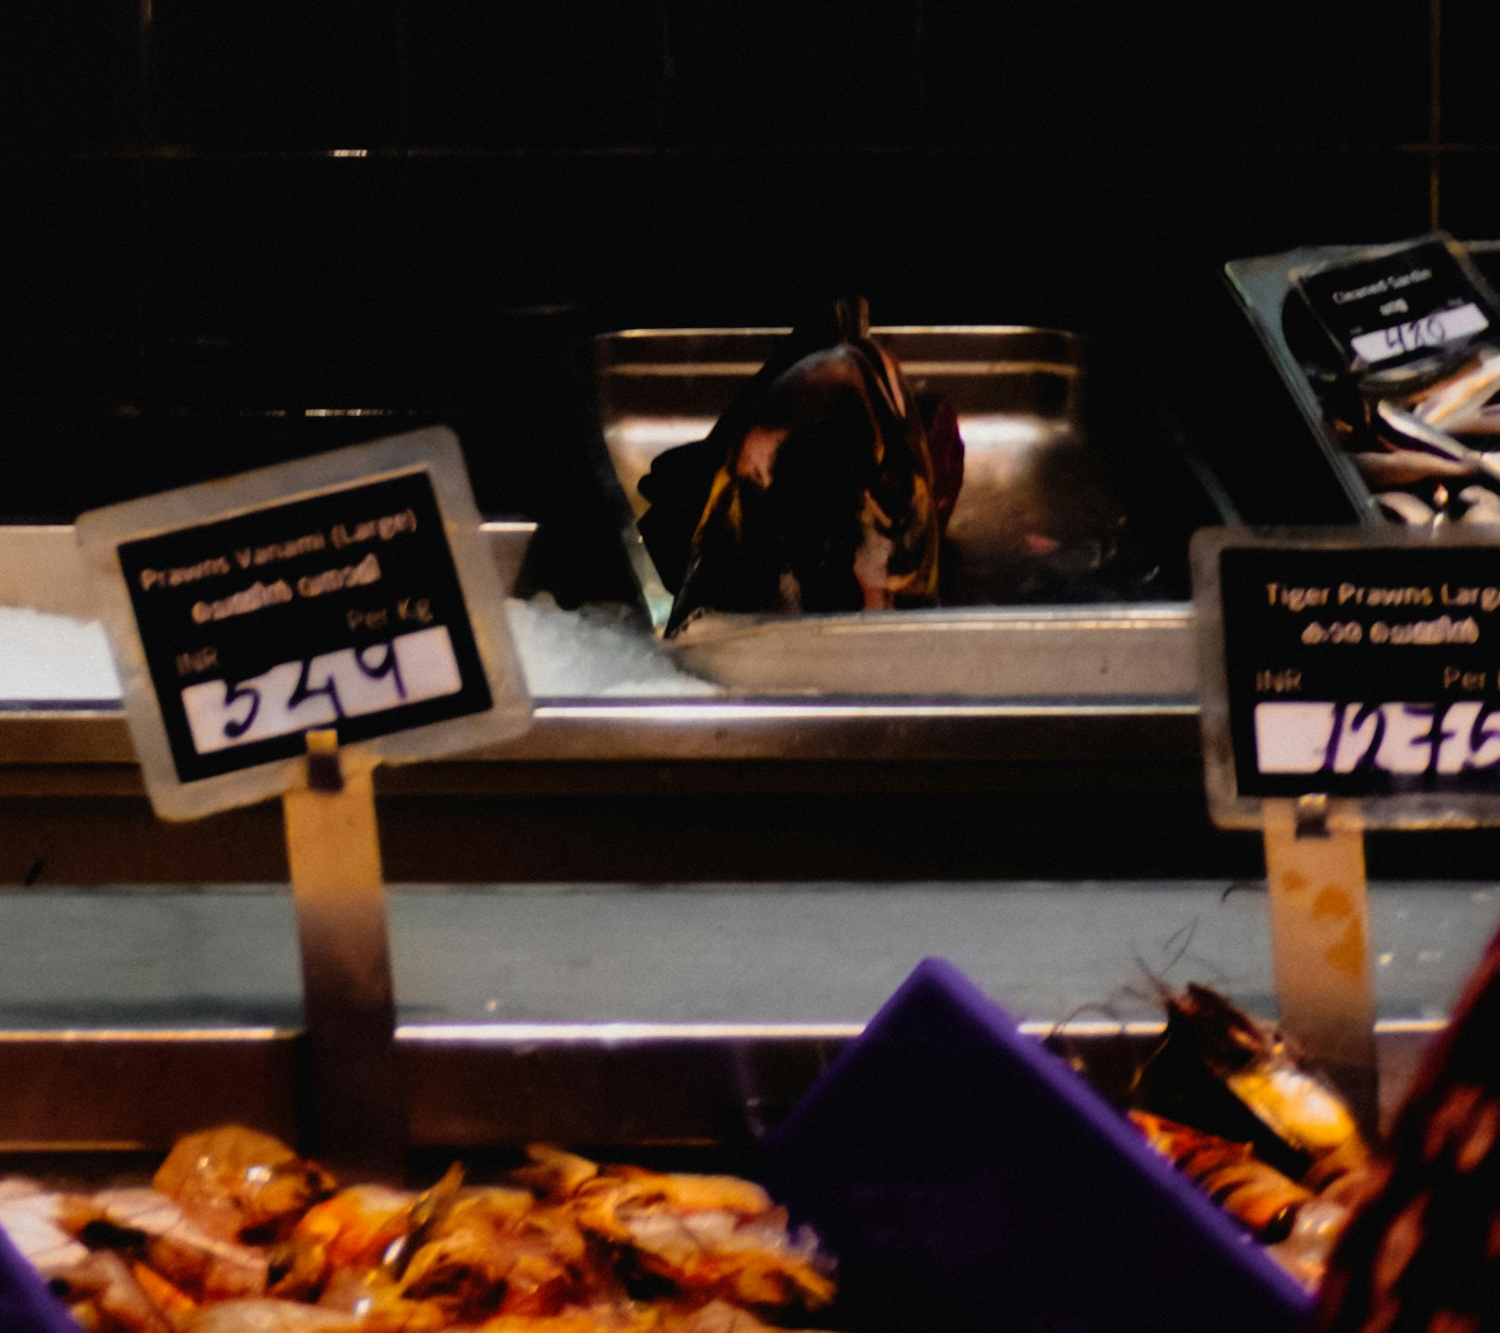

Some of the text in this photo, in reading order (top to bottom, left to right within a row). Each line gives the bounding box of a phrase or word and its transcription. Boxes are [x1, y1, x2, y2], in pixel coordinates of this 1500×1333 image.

[1266, 582, 1331, 613] Tiger
[1337, 582, 1434, 608] Prawns
[346, 608, 388, 631] Per
[396, 596, 434, 624] Kg
[1443, 664, 1487, 691] Per
